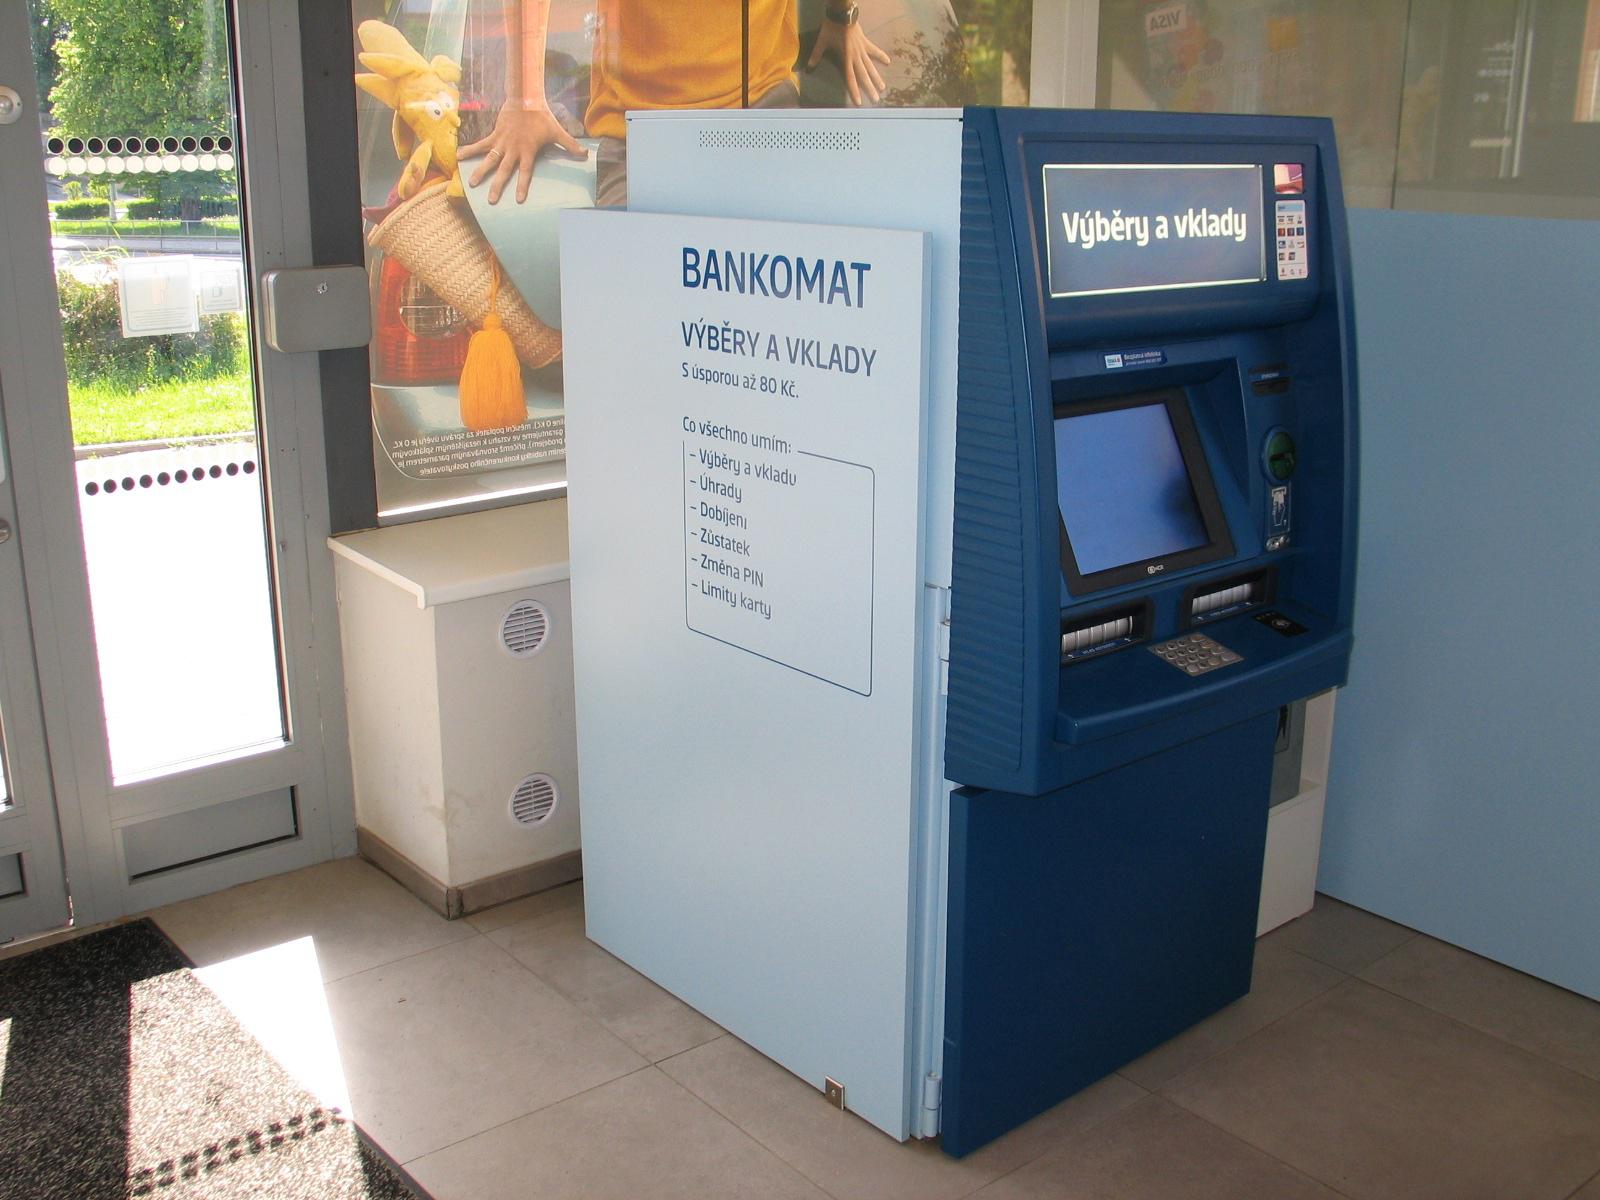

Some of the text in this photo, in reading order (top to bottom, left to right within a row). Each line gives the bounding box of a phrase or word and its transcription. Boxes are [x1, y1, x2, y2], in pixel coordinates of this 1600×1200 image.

[1062, 207, 1247, 250] Výběry a vklady
[682, 247, 872, 309] BANKOMAT
[681, 317, 877, 377] VÝBĚRY A VKLADY
[682, 362, 799, 399] S úsporou až 80 Kč.
[682, 416, 792, 454] Co všechno umím:
[699, 448, 740, 476] Výběry
[744, 462, 751, 476] a
[699, 472, 742, 504] Úhrady
[700, 528, 751, 557] Zůstatek
[701, 553, 740, 580] Změna
[743, 567, 764, 588] PIN
[701, 579, 737, 608] Limity
[740, 592, 772, 620] karty
